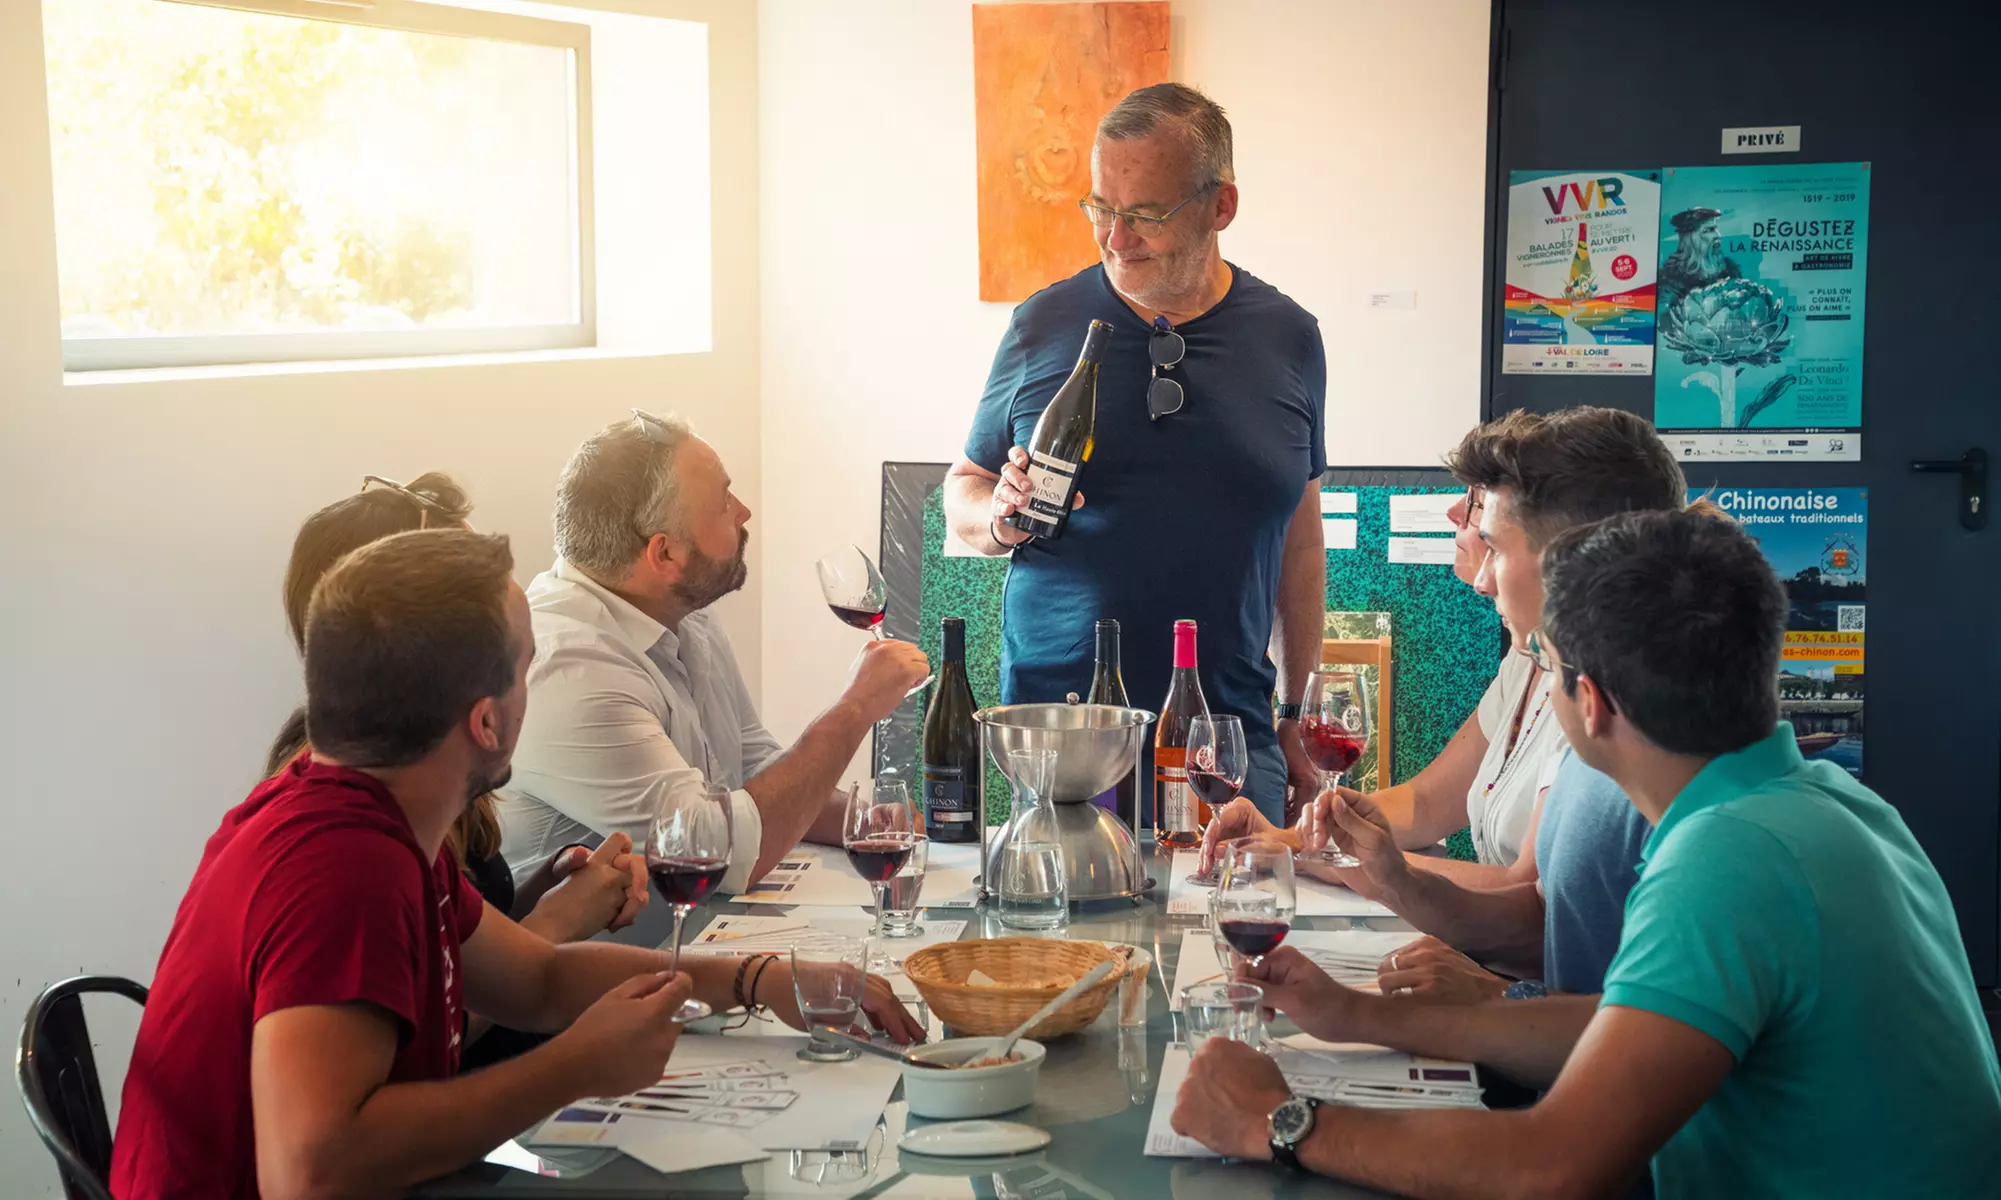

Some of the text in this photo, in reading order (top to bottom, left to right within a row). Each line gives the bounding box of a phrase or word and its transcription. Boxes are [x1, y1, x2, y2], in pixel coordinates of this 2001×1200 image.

[1737, 130, 1785, 146] PRIVÉ
[1542, 177, 1626, 215] VVR
[1803, 194, 1823, 203] 1519
[1834, 193, 1856, 202] 2019
[1594, 207, 1628, 218] RANDOS
[1561, 228, 1575, 241] 17
[1590, 237, 1603, 247] AU
[1603, 234, 1631, 245] VERT
[1529, 239, 1574, 253] BALADES
[1729, 238, 1854, 253] LA RENAISSANCE
[1516, 248, 1573, 262] VIGNERONNES
[1817, 287, 1838, 295] PLUS
[1839, 287, 1852, 295] ON
[1786, 304, 1807, 313] PLUS
[1808, 304, 1821, 312] ON
[1583, 348, 1610, 357] LOIRE
[1799, 363, 1849, 374] Leonardo
[1816, 375, 1843, 385] Vinci
[1031, 485, 1062, 501] HINON
[1718, 490, 1838, 510] Chinonaise
[1739, 512, 1864, 524] bateaux traditionnels
[1784, 633, 1858, 643] 6.76.74.51.14
[1782, 648, 1860, 657] es-chinon.com
